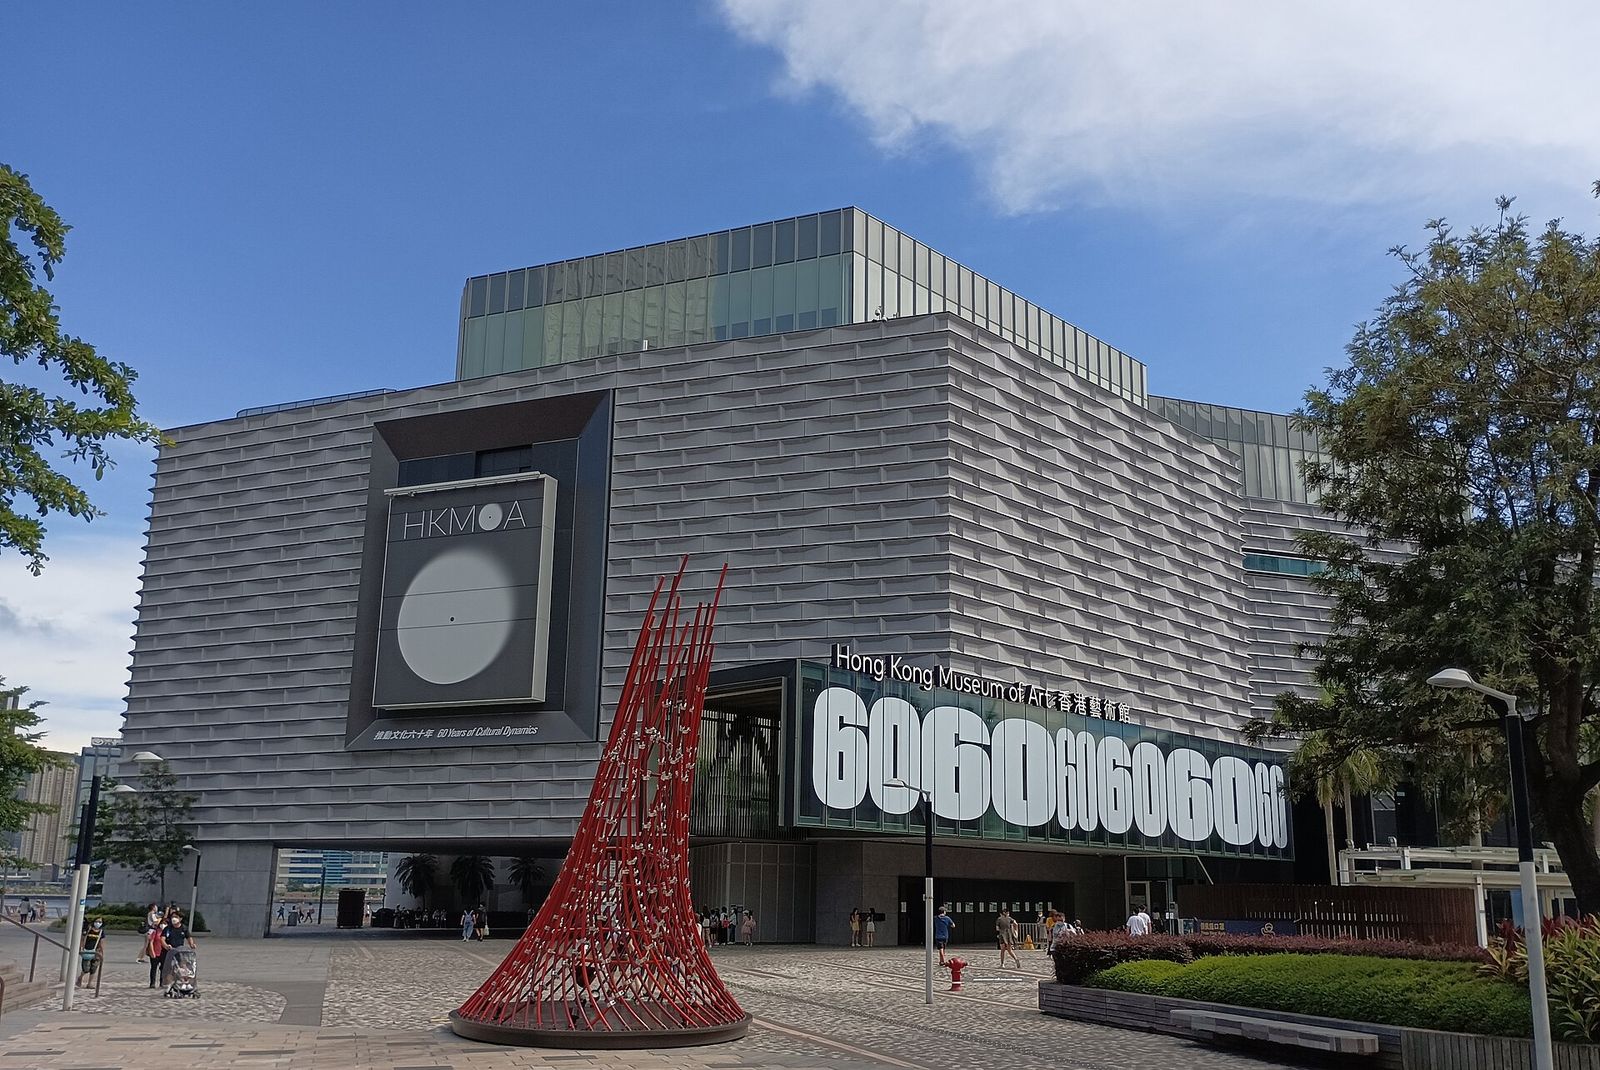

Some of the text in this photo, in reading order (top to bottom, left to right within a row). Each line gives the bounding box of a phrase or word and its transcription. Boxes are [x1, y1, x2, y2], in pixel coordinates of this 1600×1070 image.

[403, 500, 527, 540] HKMOA
[836, 643, 1131, 724] Hong Kong Museum of Art 香港藝術館
[373, 725, 539, 741] 推動文化六十年 60 Years of Cultural Dynamics
